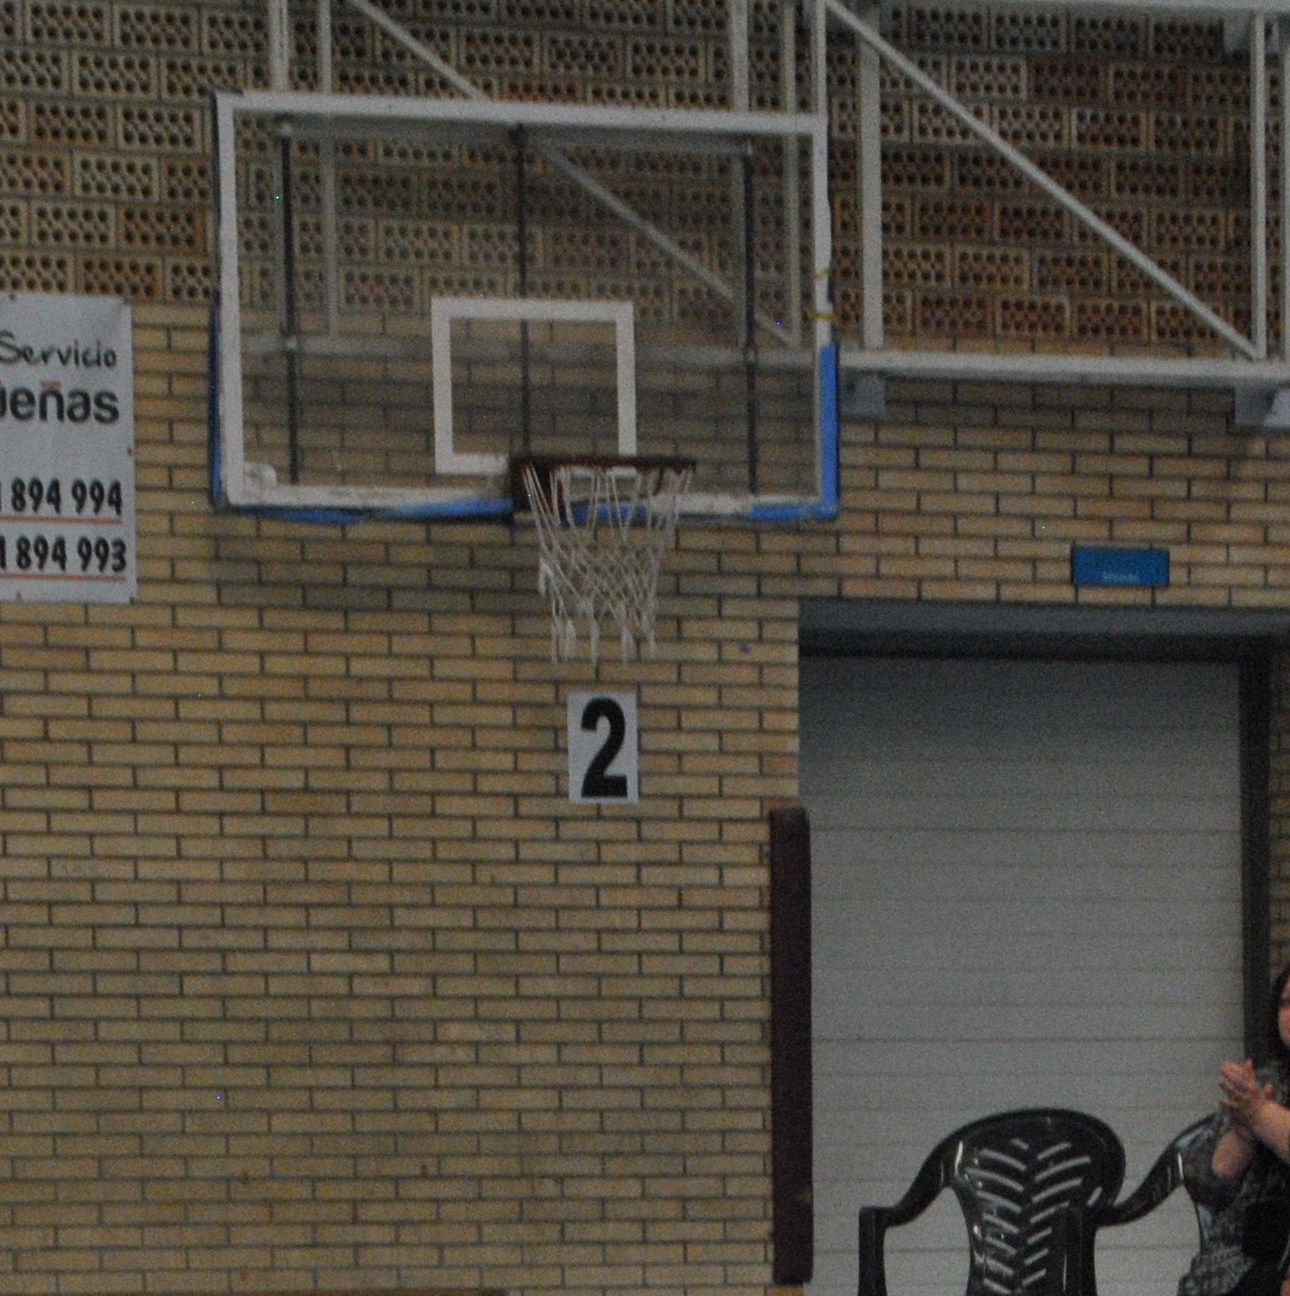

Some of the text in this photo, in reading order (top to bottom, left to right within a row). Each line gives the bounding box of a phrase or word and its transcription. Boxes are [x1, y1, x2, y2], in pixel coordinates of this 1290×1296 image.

[10, 475, 62, 514] 894
[71, 477, 124, 516] 994
[16, 534, 68, 572] 894
[77, 536, 127, 574] 993
[581, 697, 628, 798] 2
